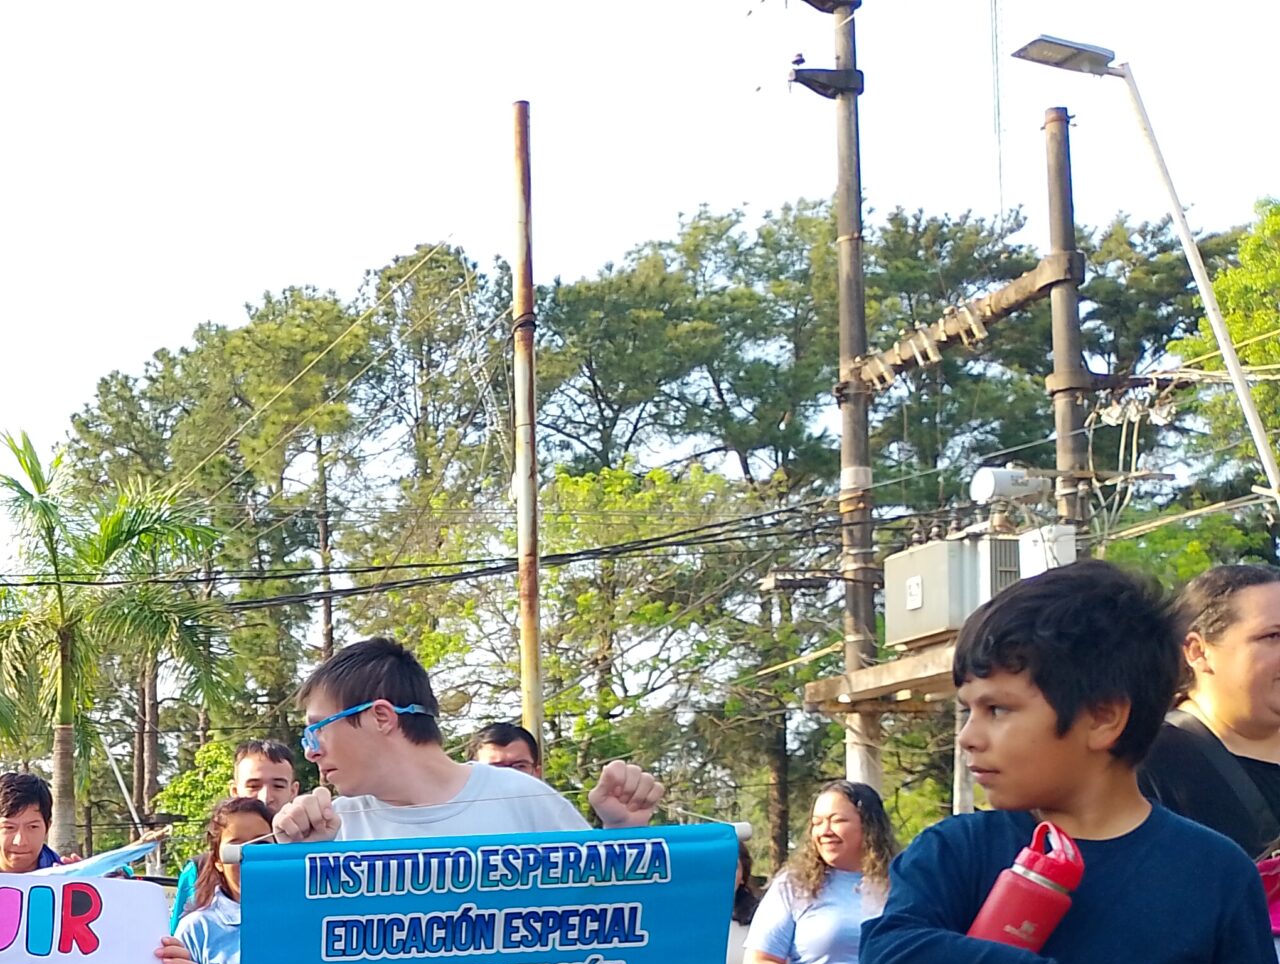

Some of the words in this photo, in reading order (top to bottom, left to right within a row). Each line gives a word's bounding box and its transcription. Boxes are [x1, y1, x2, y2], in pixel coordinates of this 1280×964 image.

[308, 850, 472, 896] INSTITUTO
[480, 841, 669, 888] ESPERANZA
[324, 906, 497, 958] EDUCACIÓN
[502, 906, 645, 950] ESPECIAL
